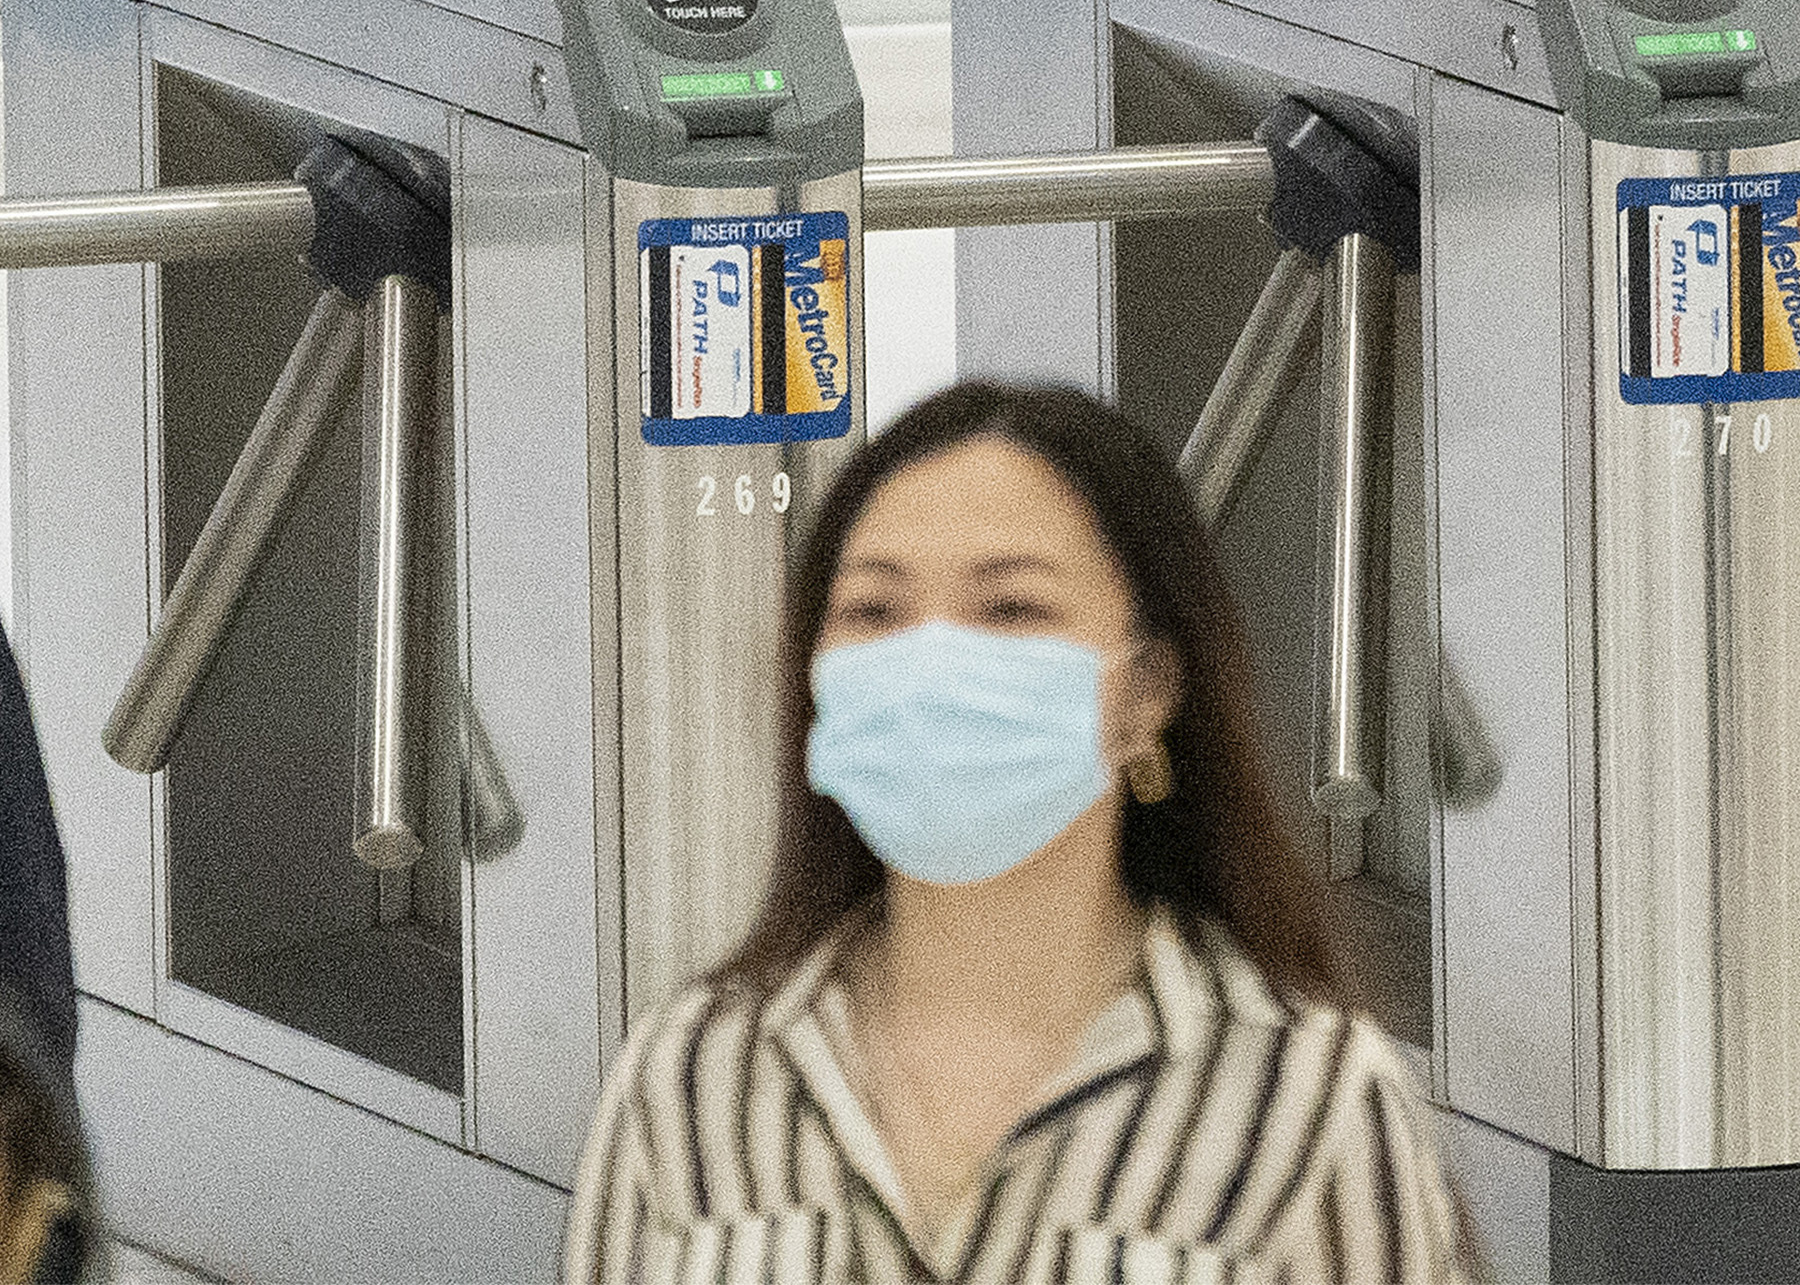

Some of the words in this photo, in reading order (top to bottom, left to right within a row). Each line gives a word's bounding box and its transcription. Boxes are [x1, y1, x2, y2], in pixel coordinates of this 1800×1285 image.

[664, 7, 708, 19] TOUCH
[711, 6, 746, 18] HERE
[1670, 182, 1727, 201] INSERT
[1730, 180, 1781, 198] TICKET
[691, 222, 747, 241] INSERT
[752, 220, 804, 239] TICKET
[1671, 239, 1687, 313] PATH
[693, 280, 709, 354] PATH
[784, 251, 843, 401] MetroCard
[1671, 413, 1772, 457] 270
[696, 472, 791, 516] 269
